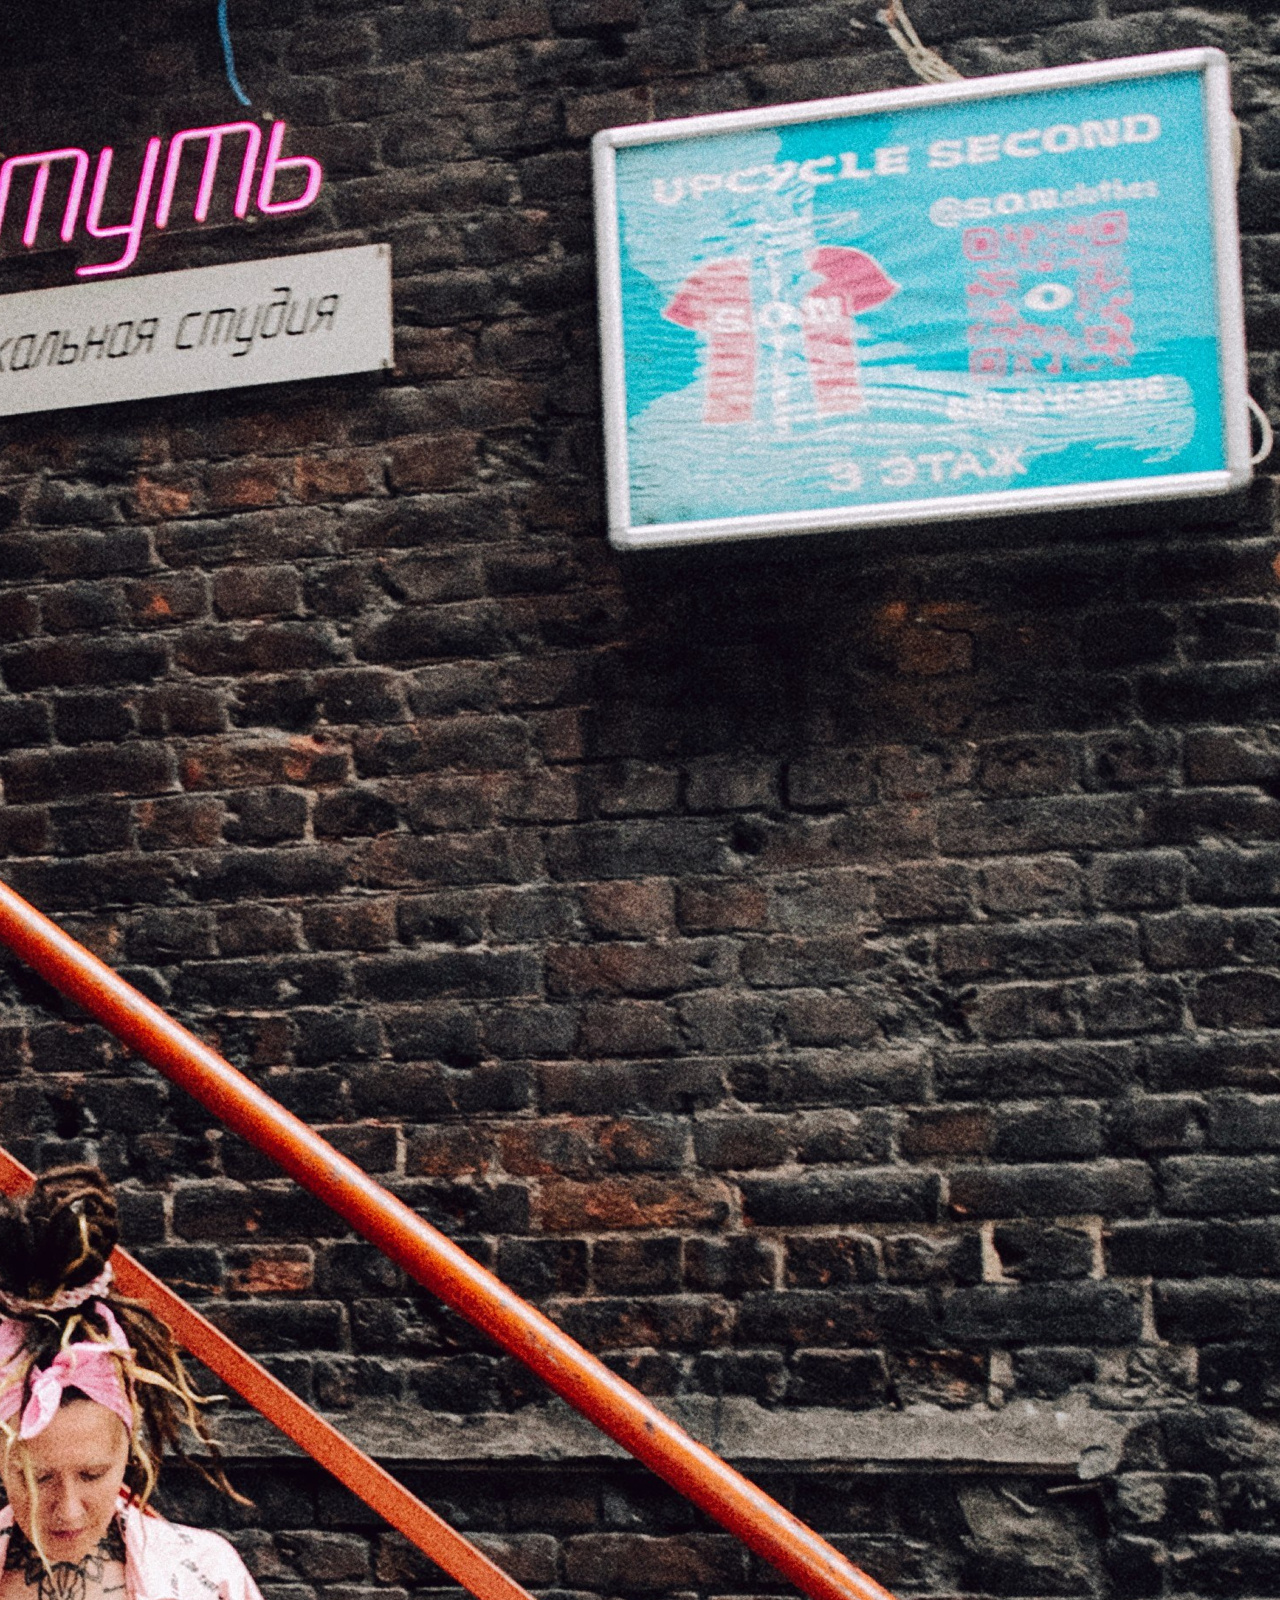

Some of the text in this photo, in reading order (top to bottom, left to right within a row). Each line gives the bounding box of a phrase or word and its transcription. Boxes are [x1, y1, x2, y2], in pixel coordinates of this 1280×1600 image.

[654, 113, 1162, 205] UPCYCLE SECOND
[175, 286, 339, 357] студия
[880, 446, 1029, 487] ЭТАЖ
